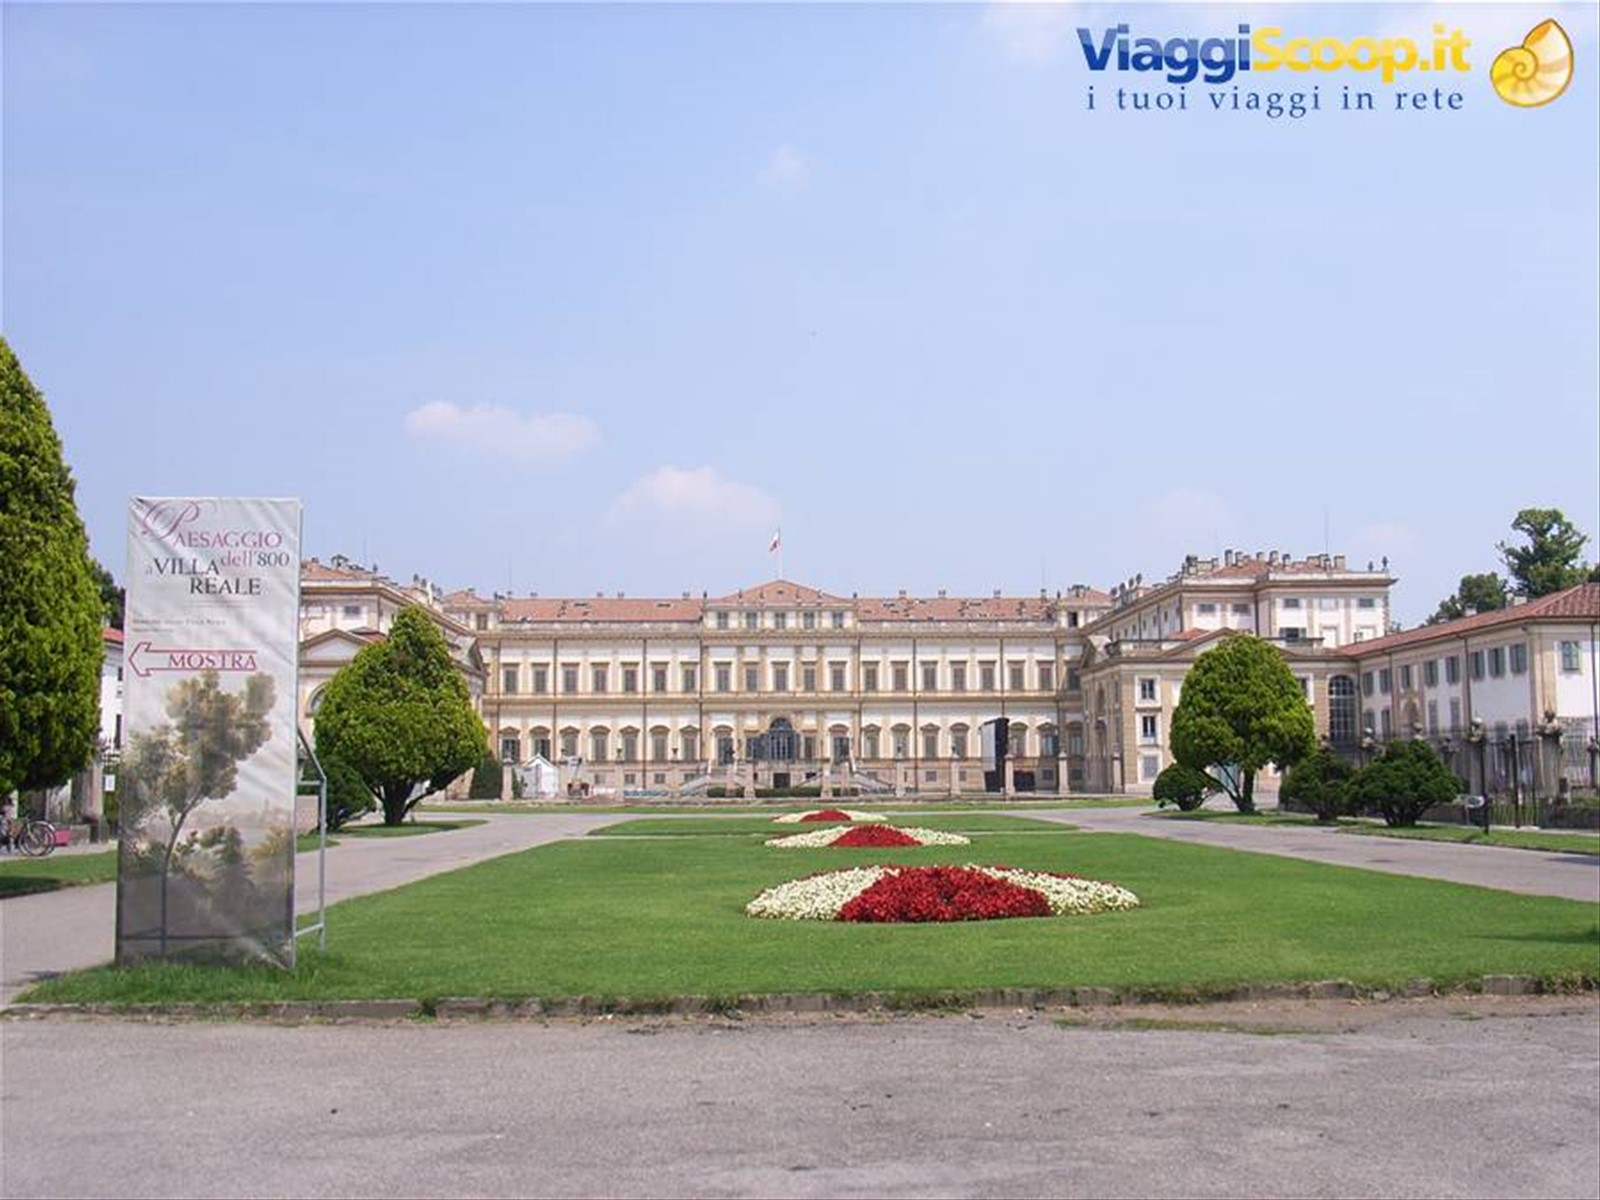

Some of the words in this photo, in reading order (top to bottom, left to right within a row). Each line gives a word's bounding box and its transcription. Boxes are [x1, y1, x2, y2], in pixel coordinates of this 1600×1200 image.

[153, 557, 220, 575] VILLA
[220, 550, 290, 567] dell'800
[190, 578, 261, 595] REALE
[168, 653, 257, 669] MOSTRA
